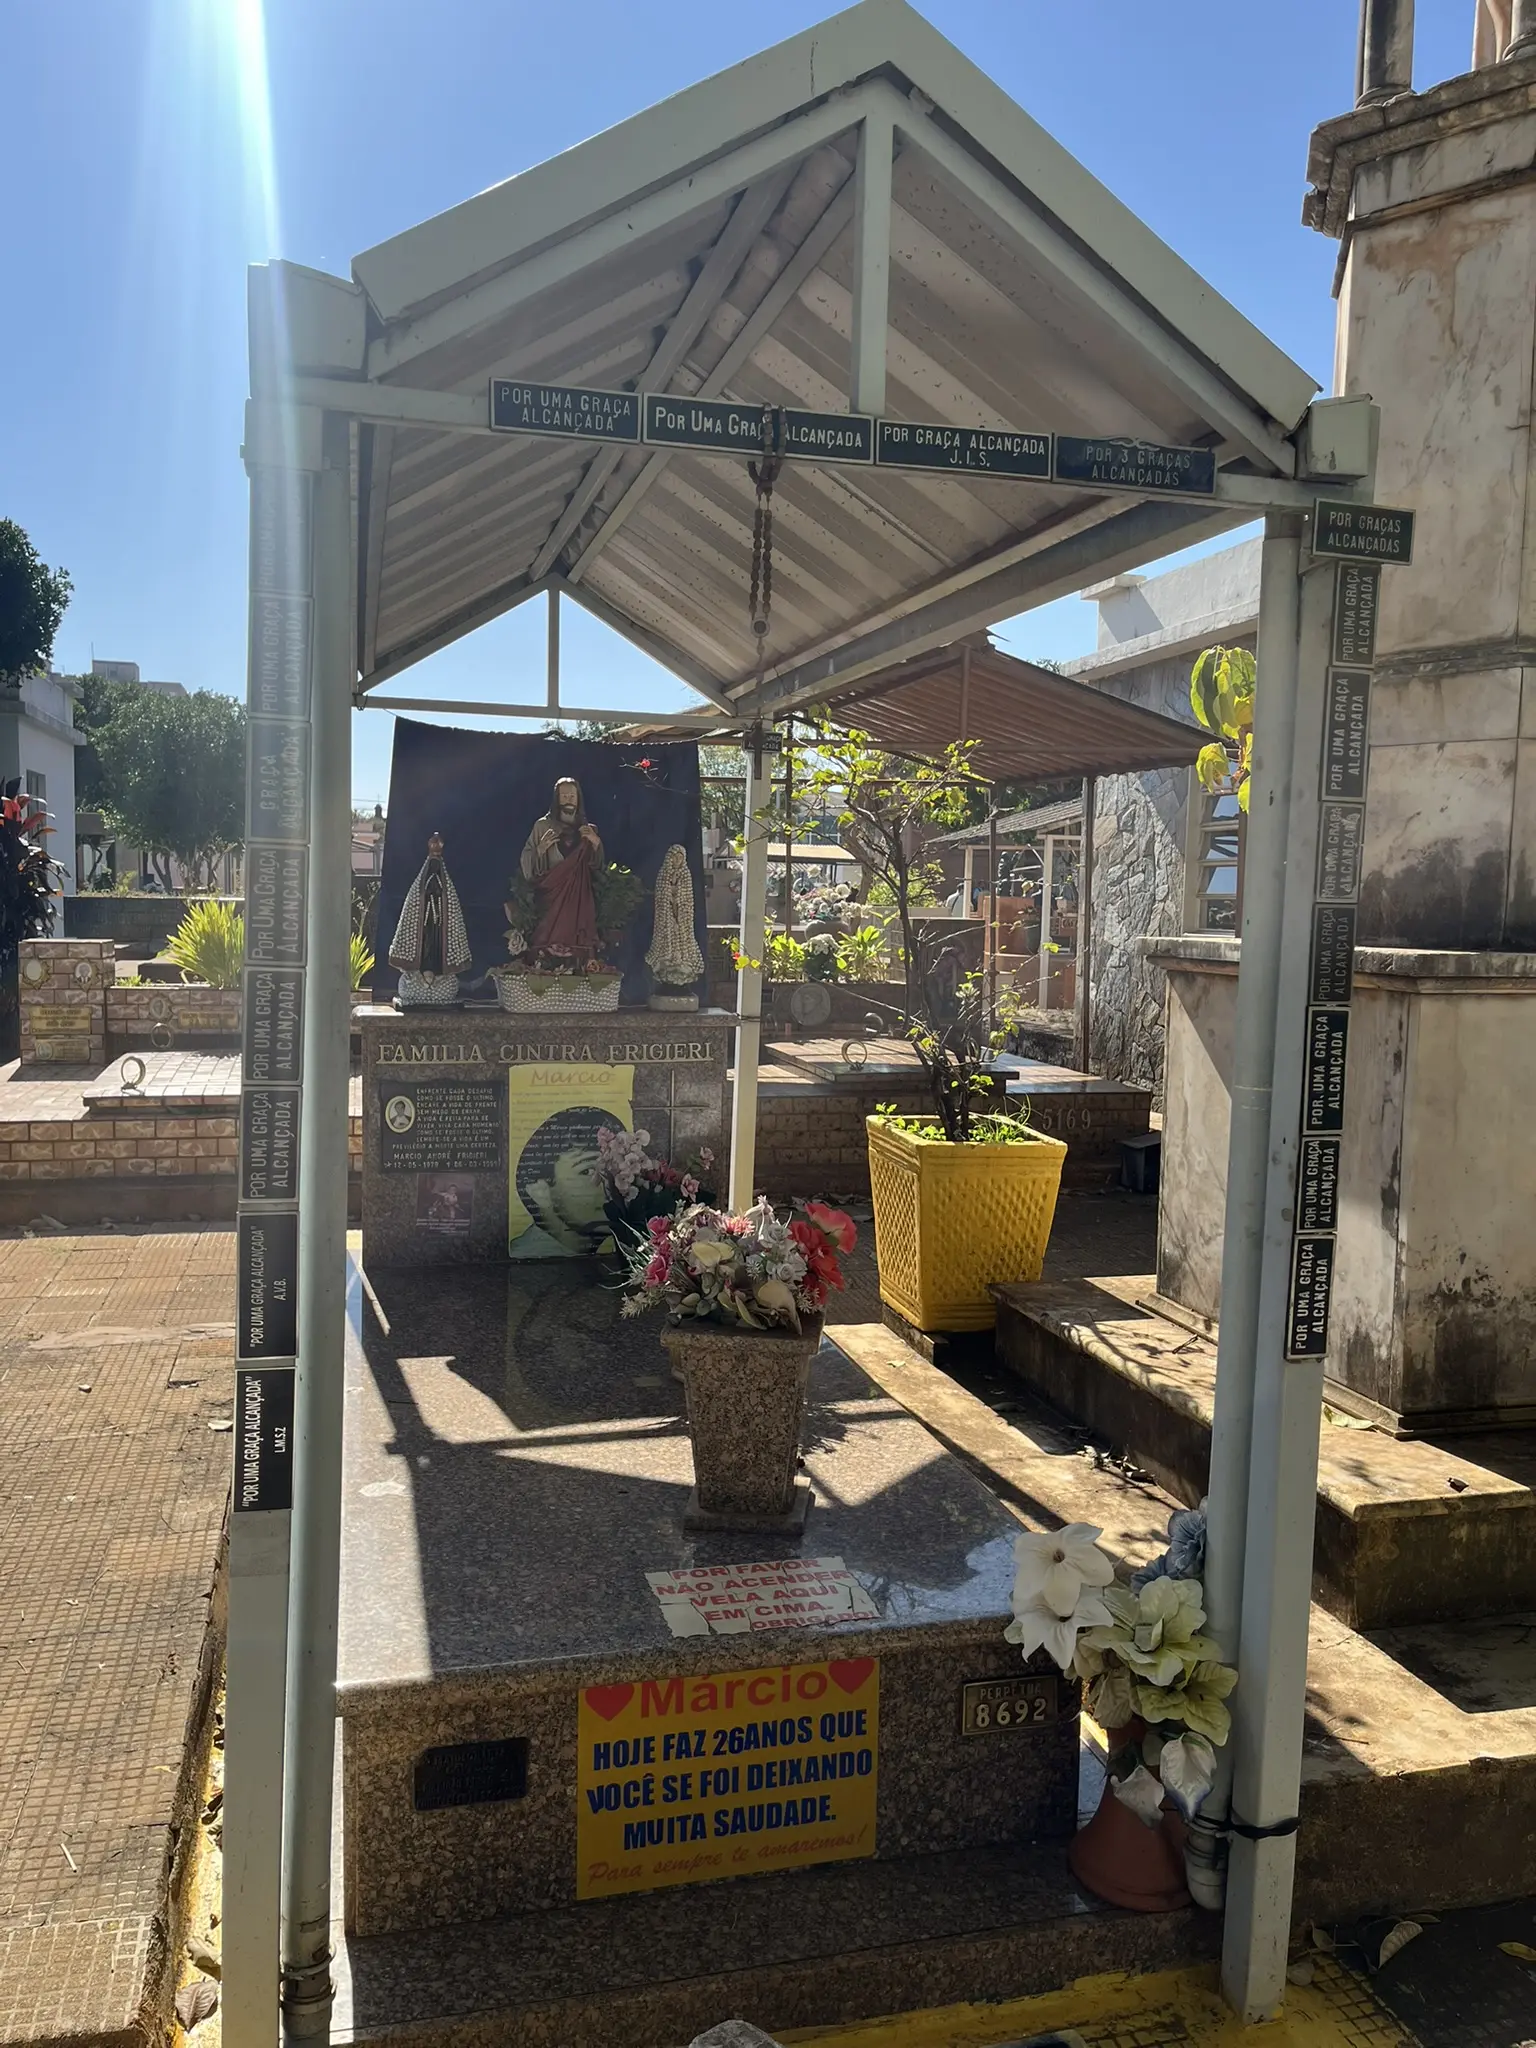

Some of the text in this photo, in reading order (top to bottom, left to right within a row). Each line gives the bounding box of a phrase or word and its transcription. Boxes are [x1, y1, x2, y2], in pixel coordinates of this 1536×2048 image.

[501, 387, 631, 418] POR UMA GRAÇA
[521, 411, 614, 432] ALCANÇADA
[655, 406, 686, 432] POR
[691, 411, 723, 434] UMA
[883, 426, 1045, 456] POR GRAÇA ALCANÇADA
[1086, 445, 1192, 474] POR 3 GRAÇAS
[1091, 464, 1180, 487] ALCANÇADAS
[1329, 510, 1401, 536] POR GRAÇAS
[1327, 533, 1401, 556] ALCANÇADAS
[1342, 567, 1360, 661] POR UMA GRAÇA
[1357, 575, 1374, 655] ALCANÇADA
[262, 601, 284, 712] POR UMA GRAÇA
[1330, 677, 1350, 790] POR UMA GRAÇA
[1348, 694, 1365, 776] ALCANÇADA
[251, 850, 281, 960] POR UMA GRAÇA
[277, 857, 303, 954] ALCANÇADA
[1318, 908, 1337, 1001] POR UMA GRAÇA
[1333, 916, 1351, 994] ALCANÇADA
[253, 972, 276, 1080] POR UMA GRAÇA
[276, 981, 299, 1070] ALCANÇADA
[1314, 1015, 1330, 1058] GRAÇA
[377, 1042, 713, 1062] FAMILIA CINTRA FRIGIERI
[1328, 1031, 1345, 1109] ALCANÇADA
[1312, 1065, 1326, 1092] UMA
[1042, 1108, 1092, 1131] 5169
[250, 1091, 272, 1198] POR UMA GRAÇA
[272, 1100, 297, 1188] ALCANÇADA
[1304, 1139, 1323, 1229] POR UMA GRAÇA
[1319, 1146, 1337, 1223] ALCANÇADA
[251, 1278, 267, 1305] GRAÇA
[273, 1277, 287, 1301] A.V.B.
[1295, 1242, 1316, 1350] POR UMA GRAÇA
[1311, 1257, 1329, 1335] ALCANÇADA
[251, 1306, 264, 1326] UMA
[244, 1431, 264, 1460] GRAÇA
[243, 1461, 260, 1483] UMA
[655, 1570, 850, 1595] NÃO ACENDER
[672, 1559, 821, 1580] POR FAVOR
[691, 1585, 839, 1607] VELA AQUI
[704, 1608, 745, 1621] EM
[976, 1698, 1047, 1728] 8692
[593, 1735, 656, 1771] HOJE
[662, 1729, 707, 1761] FAZ
[820, 1709, 868, 1743] QUE
[586, 1749, 873, 1815] VOCÊ SE FOI DEIXANDO
[624, 1795, 837, 1850] MUITA SAUDADE.
[587, 1861, 643, 1885] Para
[653, 1853, 723, 1877] sempre
[732, 1847, 748, 1863] te
